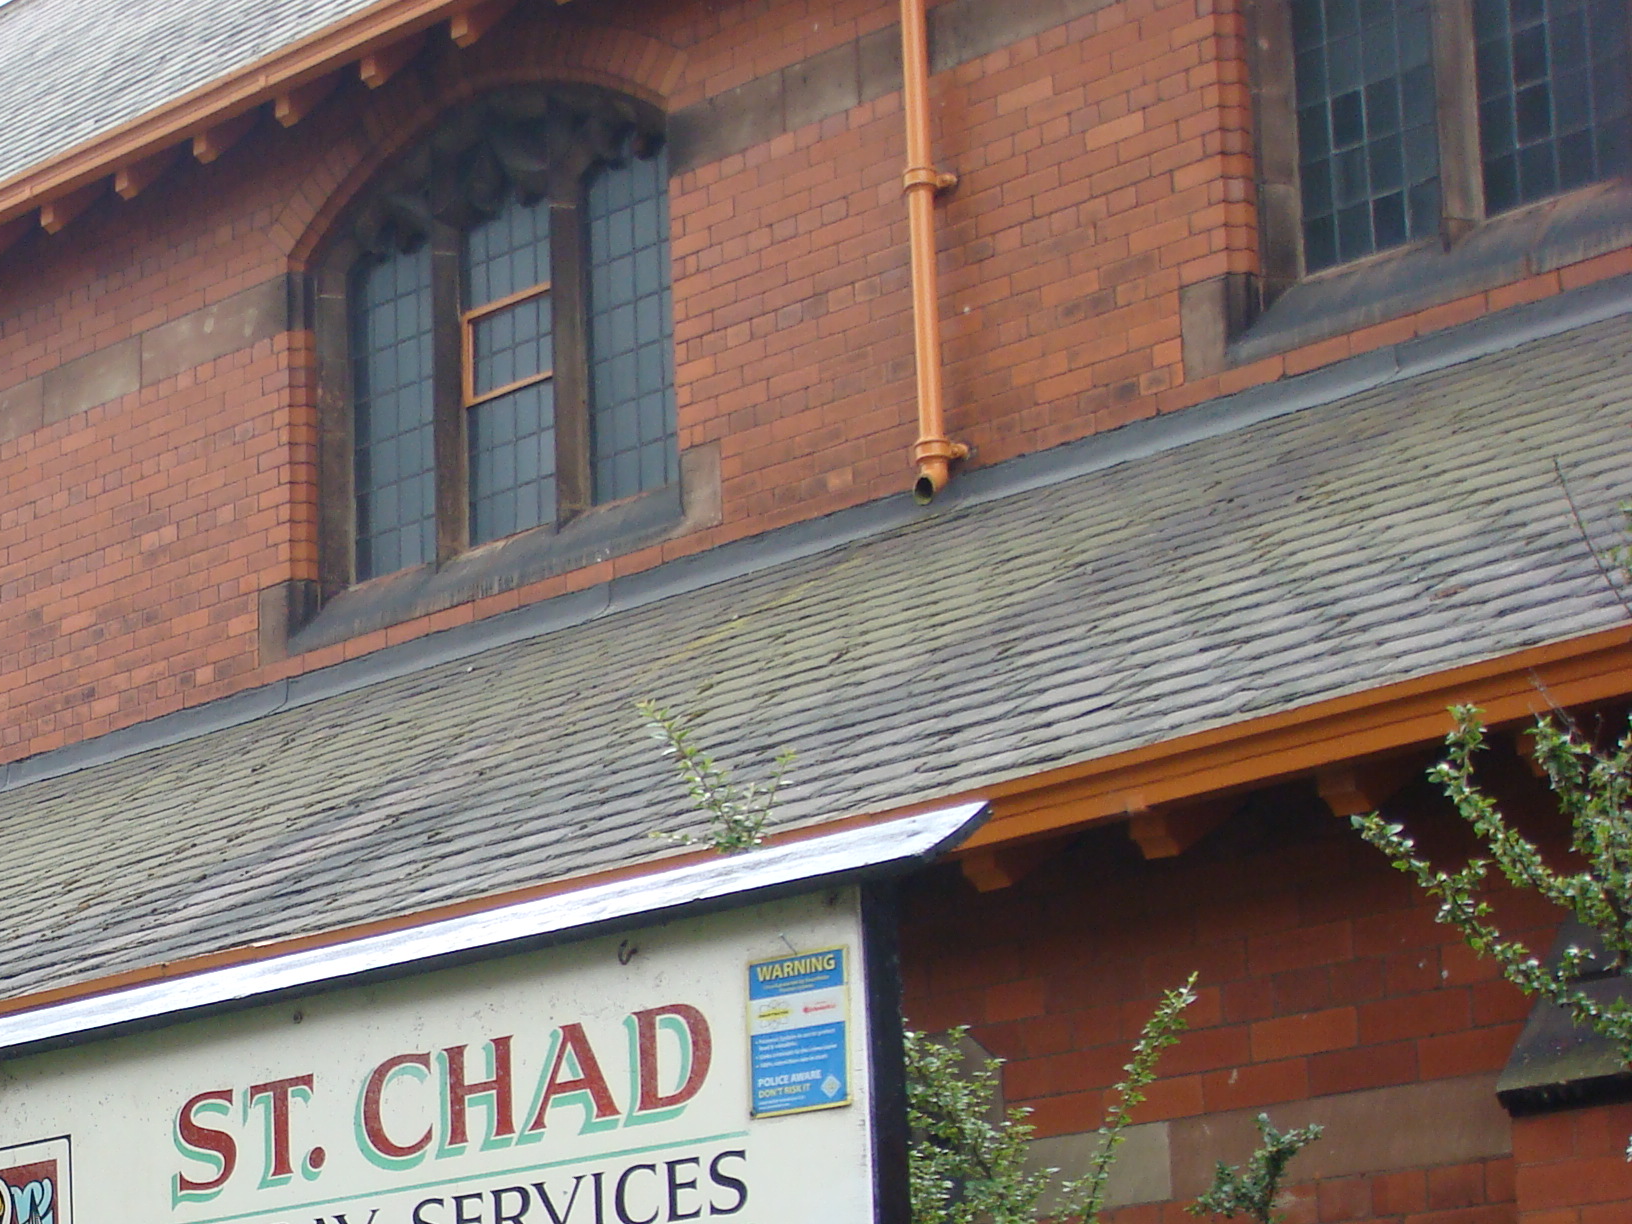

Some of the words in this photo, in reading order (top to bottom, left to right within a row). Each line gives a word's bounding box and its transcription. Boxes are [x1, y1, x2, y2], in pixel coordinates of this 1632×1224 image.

[757, 954, 836, 982] WARNING
[172, 1073, 326, 1210] ST.
[354, 1003, 712, 1171] CHAD
